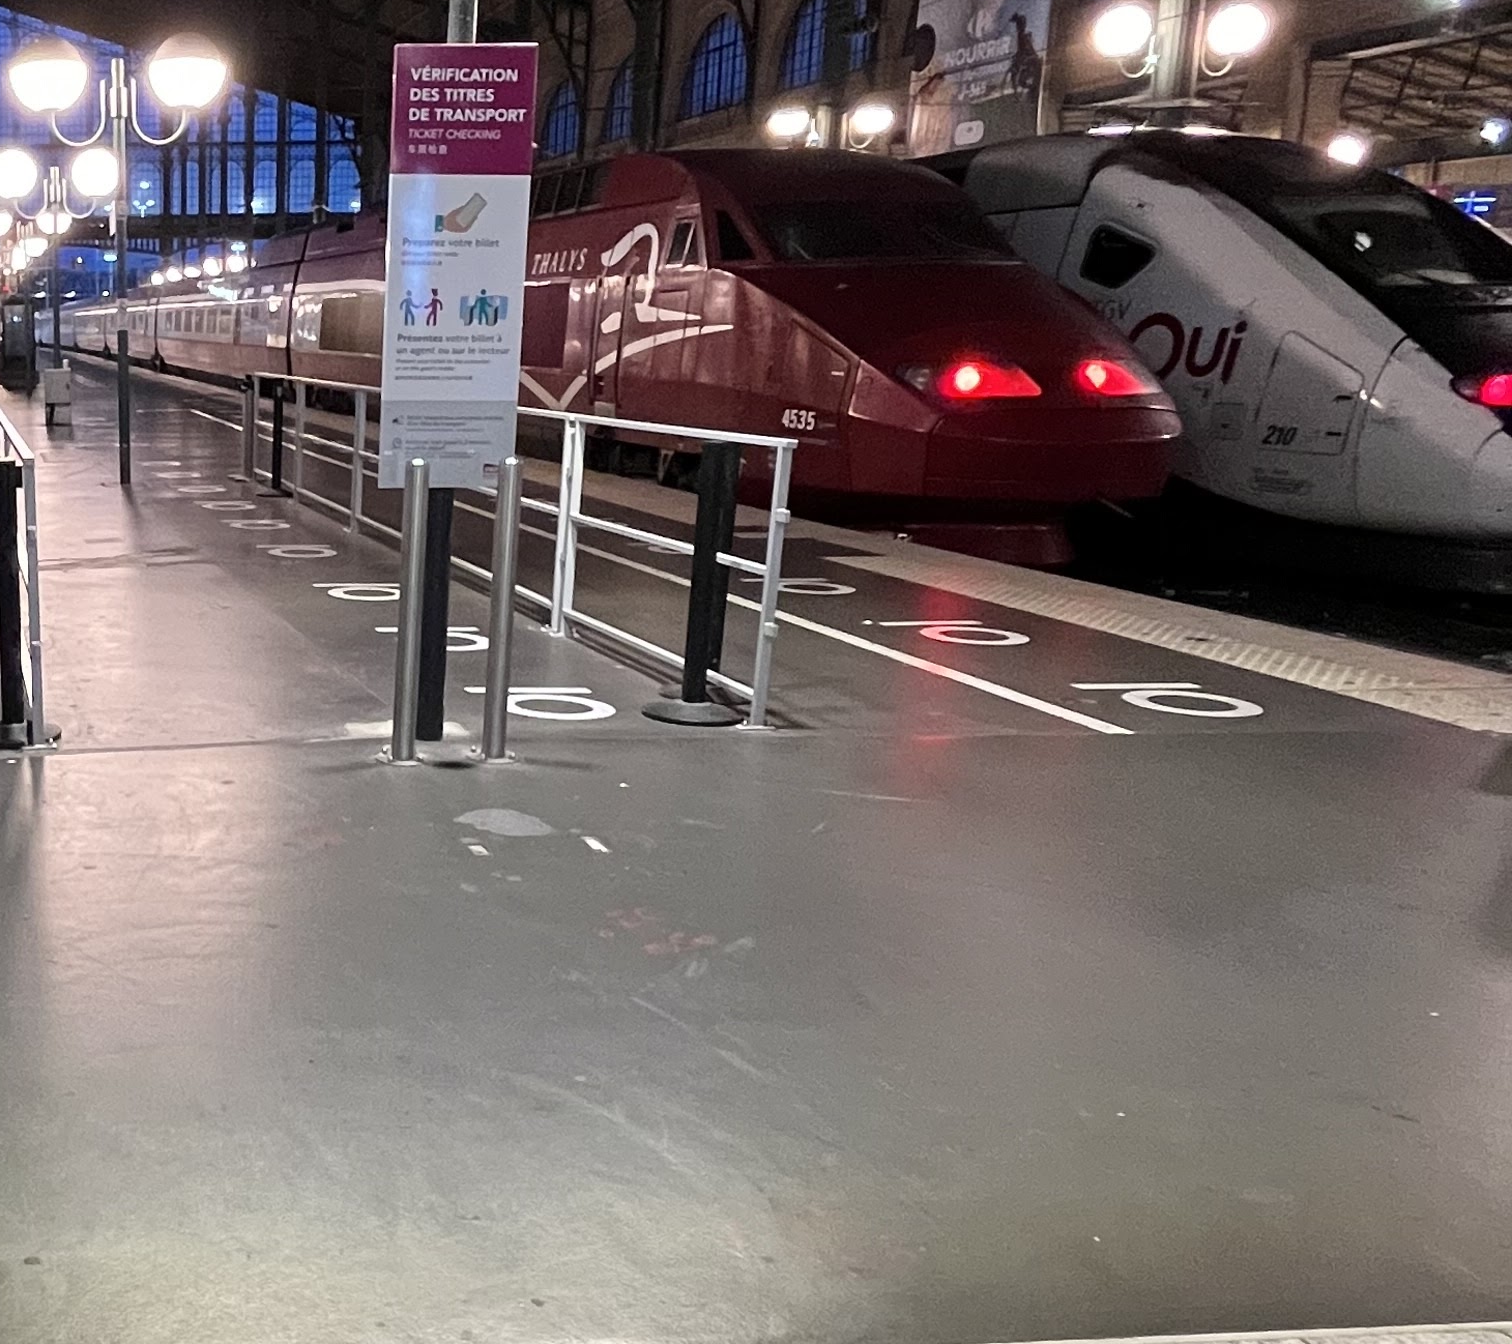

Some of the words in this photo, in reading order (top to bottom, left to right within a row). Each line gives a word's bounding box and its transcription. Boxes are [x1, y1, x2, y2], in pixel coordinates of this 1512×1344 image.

[410, 65, 519, 83] VÉRIFICATION
[409, 88, 439, 102] DES
[444, 88, 495, 102] TITRES
[408, 108, 430, 121] DE
[435, 108, 527, 122] TRANSPORT
[408, 128, 444, 139] TICKET
[445, 129, 502, 140] CHECKING
[531, 247, 588, 275] THALYS
[781, 408, 817, 431] 4535
[1262, 425, 1298, 446] 210
